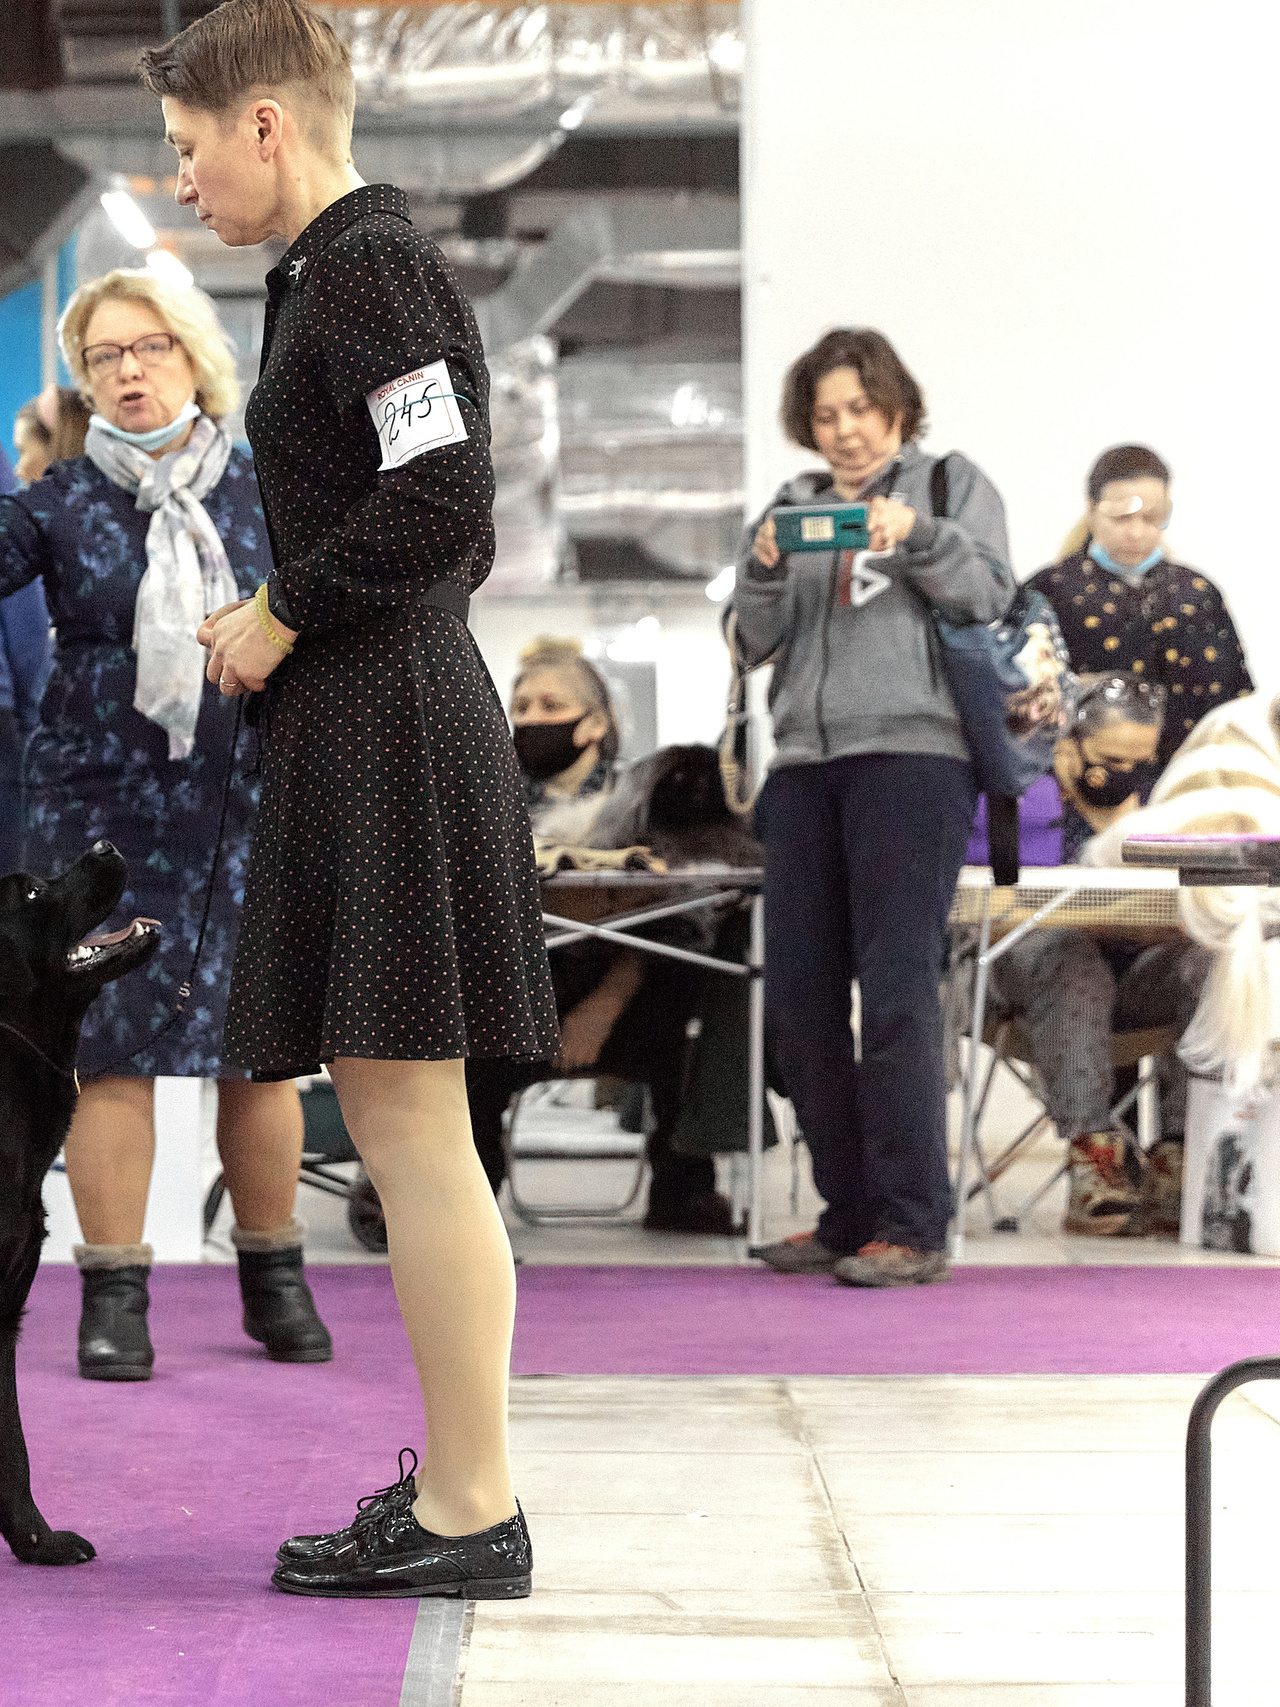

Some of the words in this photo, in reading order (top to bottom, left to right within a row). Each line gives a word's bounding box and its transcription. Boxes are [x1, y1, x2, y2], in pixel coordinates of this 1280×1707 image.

[377, 382, 396, 400] ROYAL
[397, 371, 424, 387] CANIN
[384, 382, 437, 446] 245
